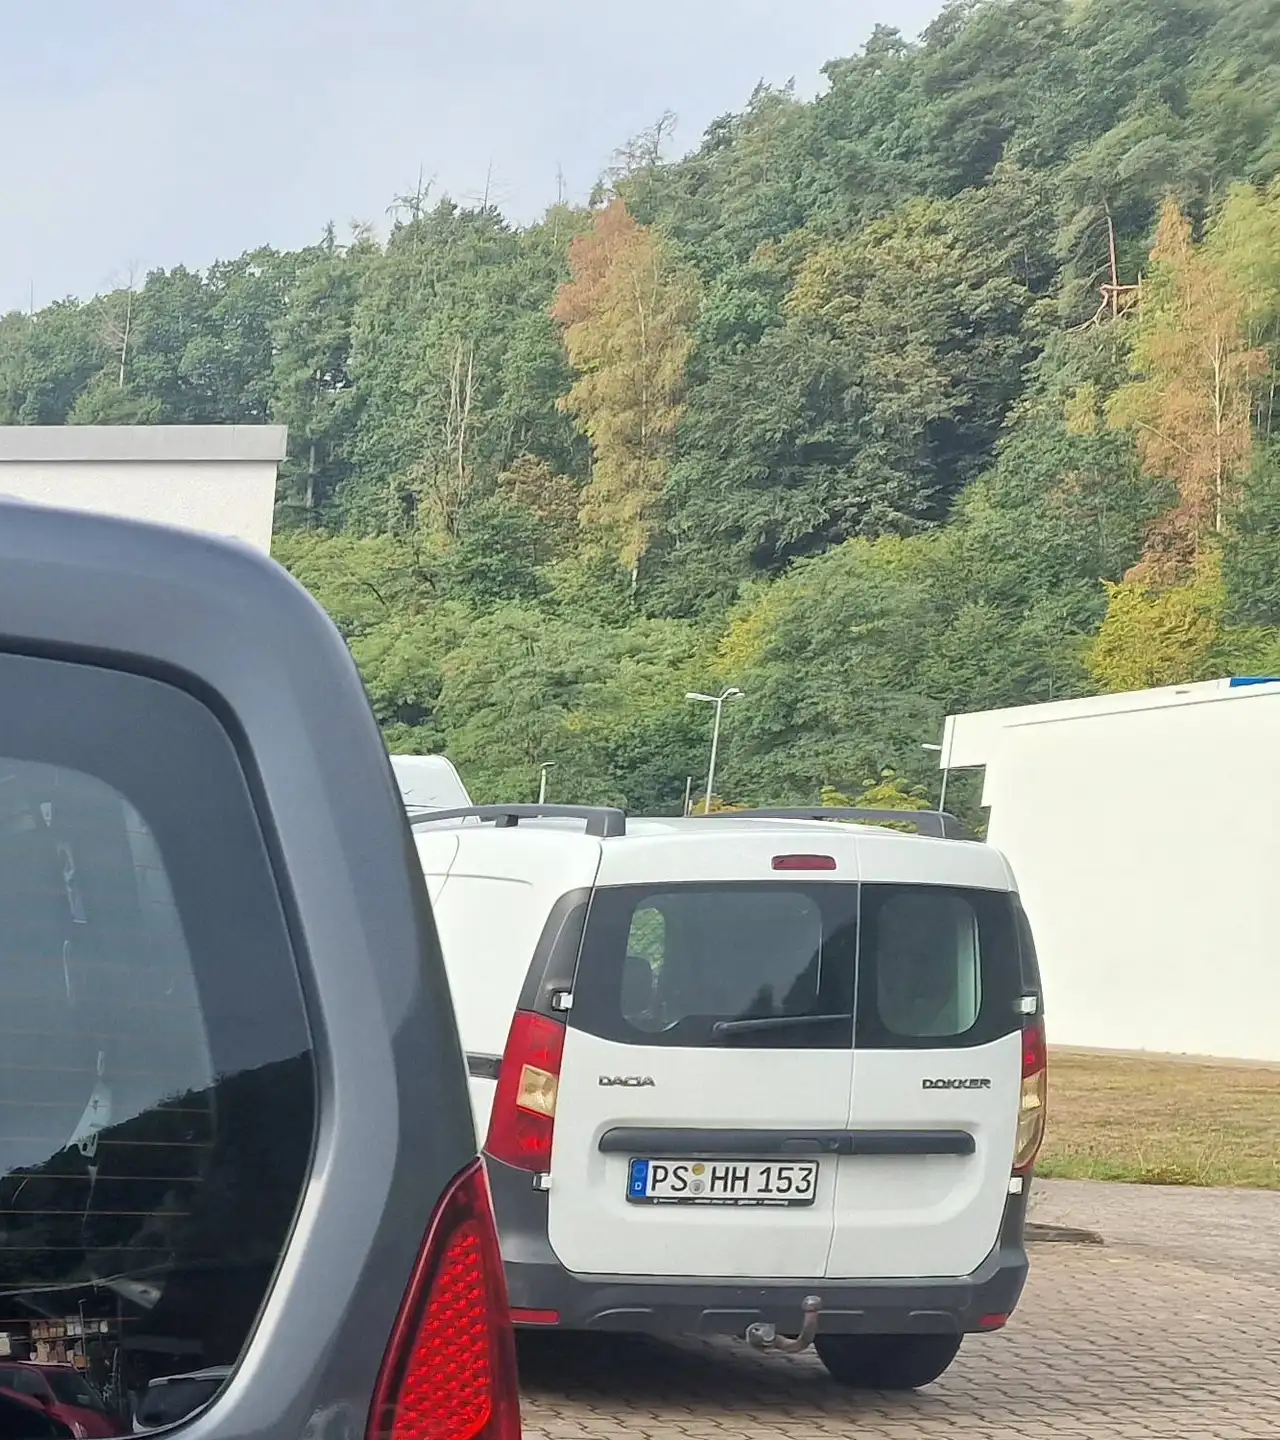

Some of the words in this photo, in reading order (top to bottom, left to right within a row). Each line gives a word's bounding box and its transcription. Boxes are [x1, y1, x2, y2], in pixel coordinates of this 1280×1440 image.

[598, 1075, 656, 1087] DACIA
[922, 1079, 992, 1090] DOKKER
[650, 1165, 689, 1192] PS
[709, 1166, 750, 1193] HH
[757, 1166, 814, 1194] 153
[634, 1182, 642, 1190] D
